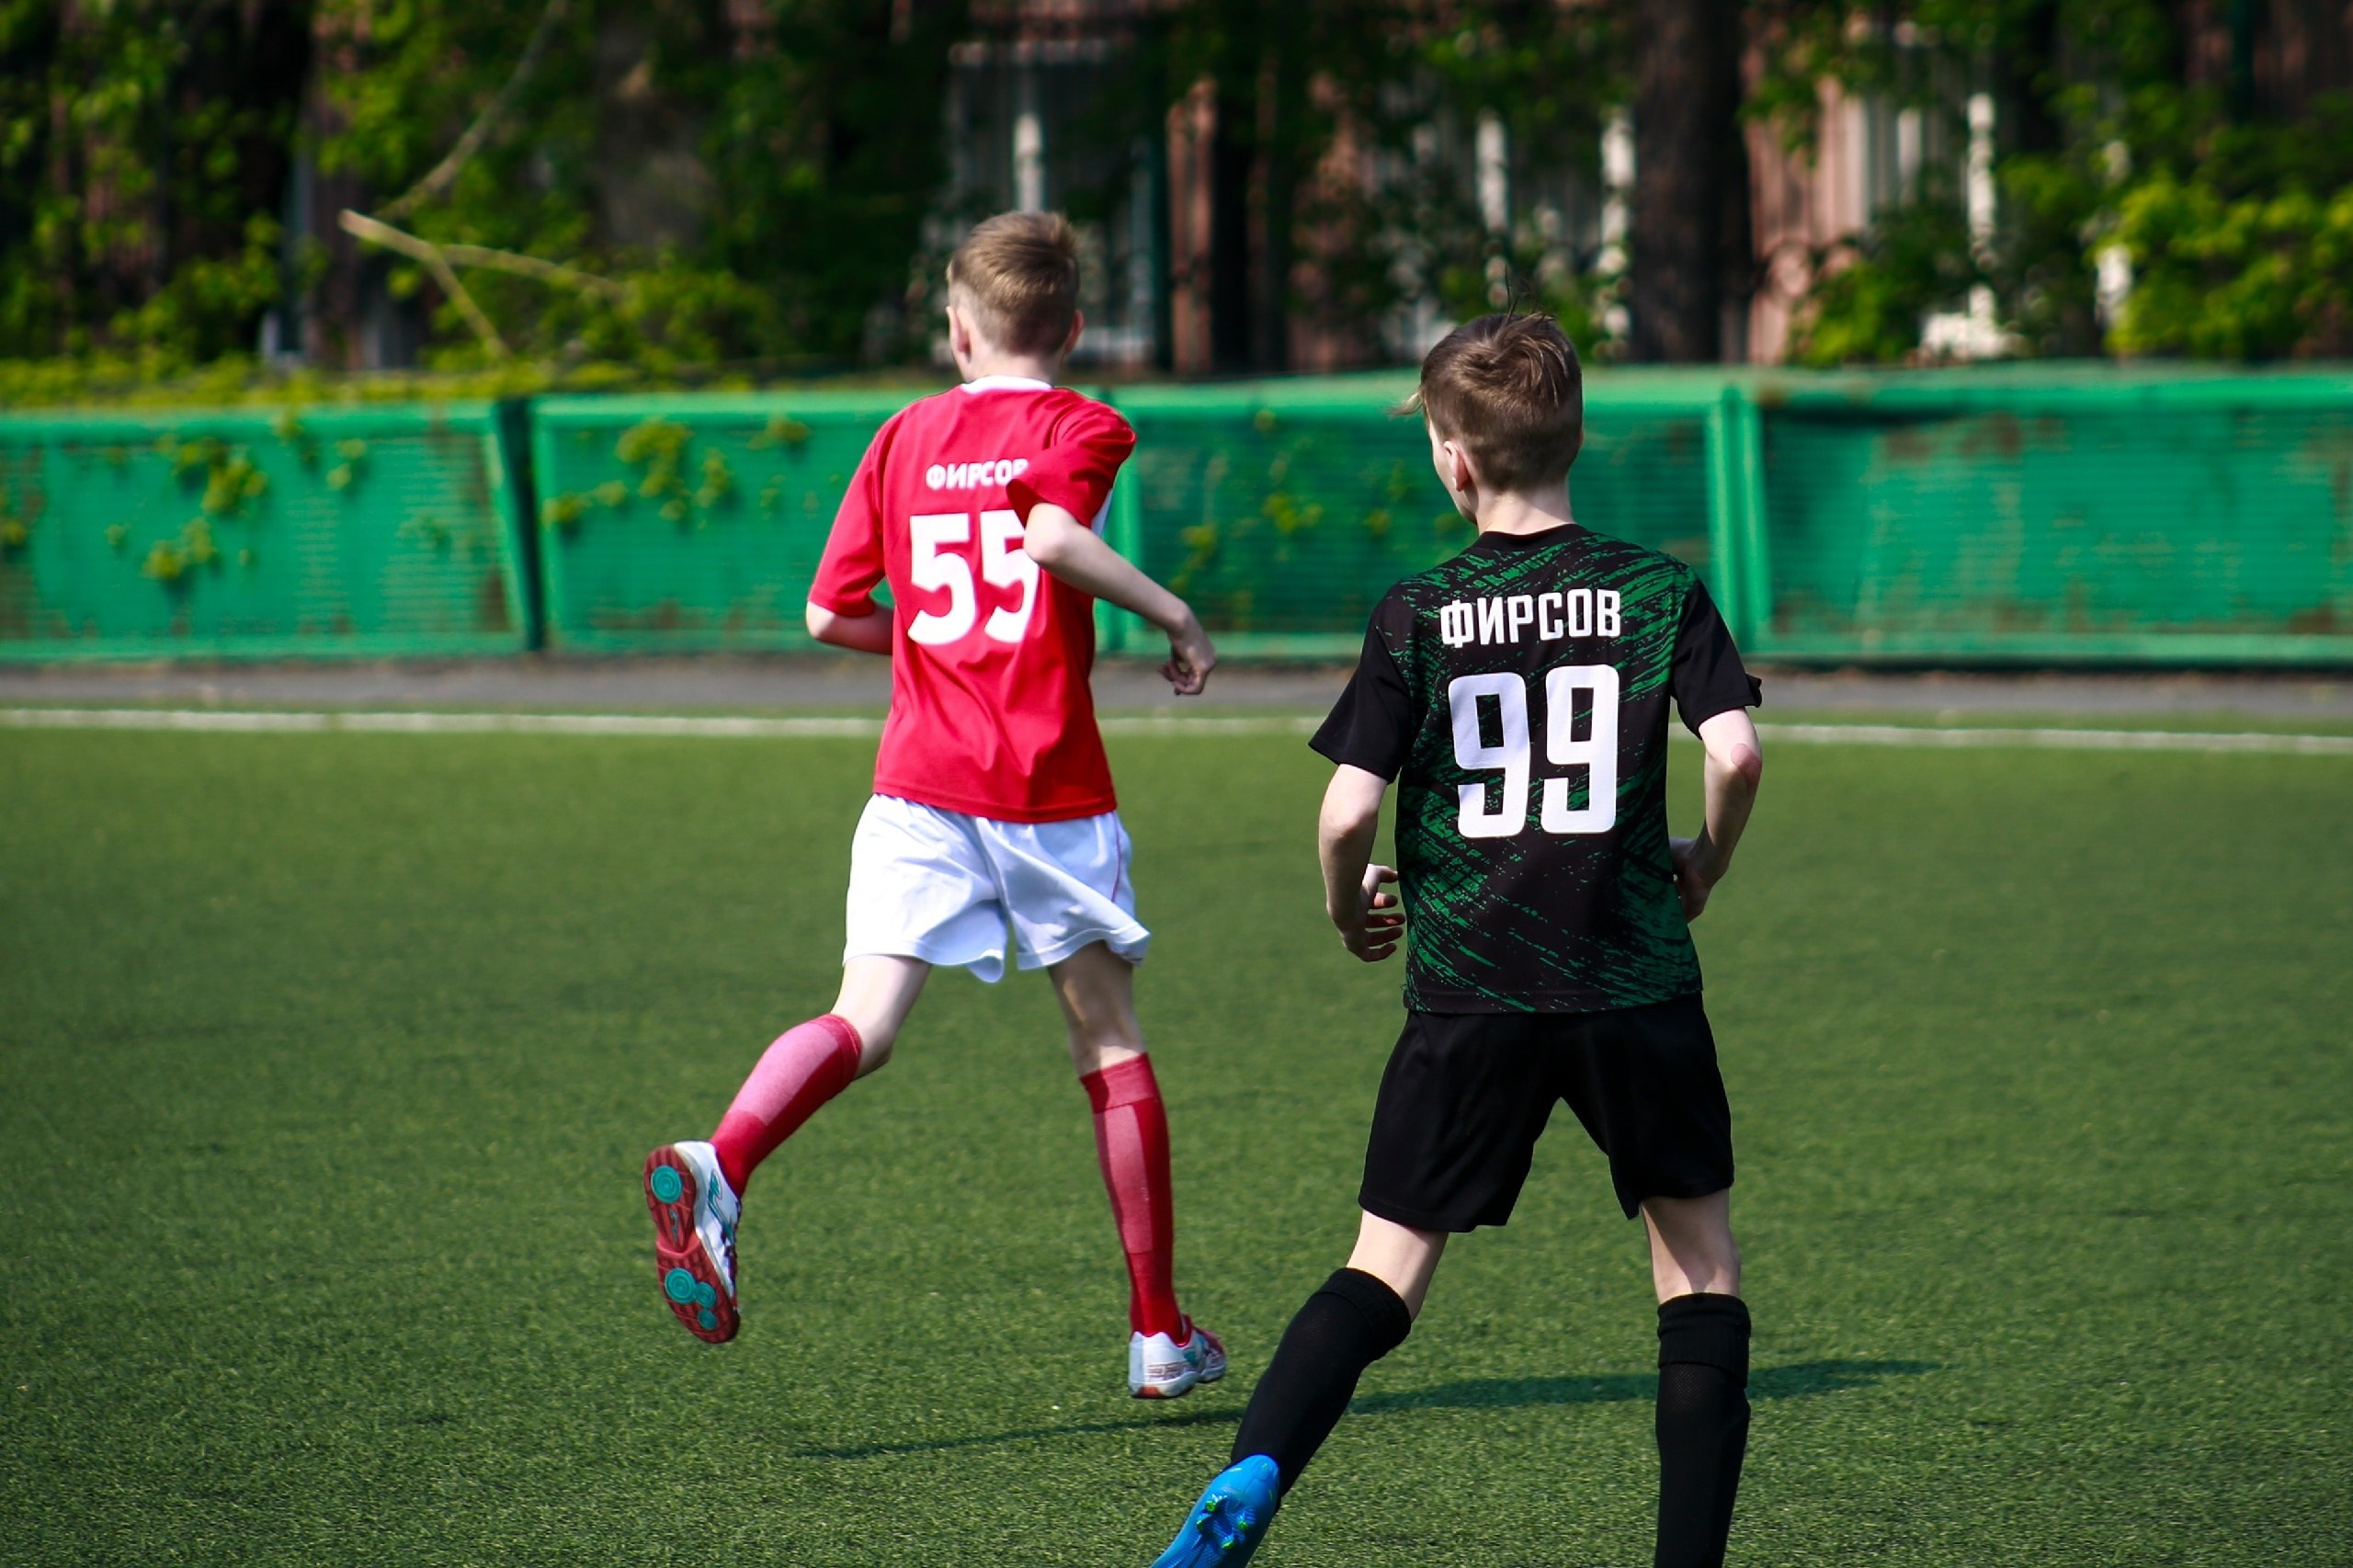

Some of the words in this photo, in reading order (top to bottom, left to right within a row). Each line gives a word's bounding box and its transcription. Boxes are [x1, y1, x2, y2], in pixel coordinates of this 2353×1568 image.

[907, 509, 1040, 644] 55
[1439, 588, 1620, 648] ФИРСОВ
[1448, 664, 1620, 838] 99
